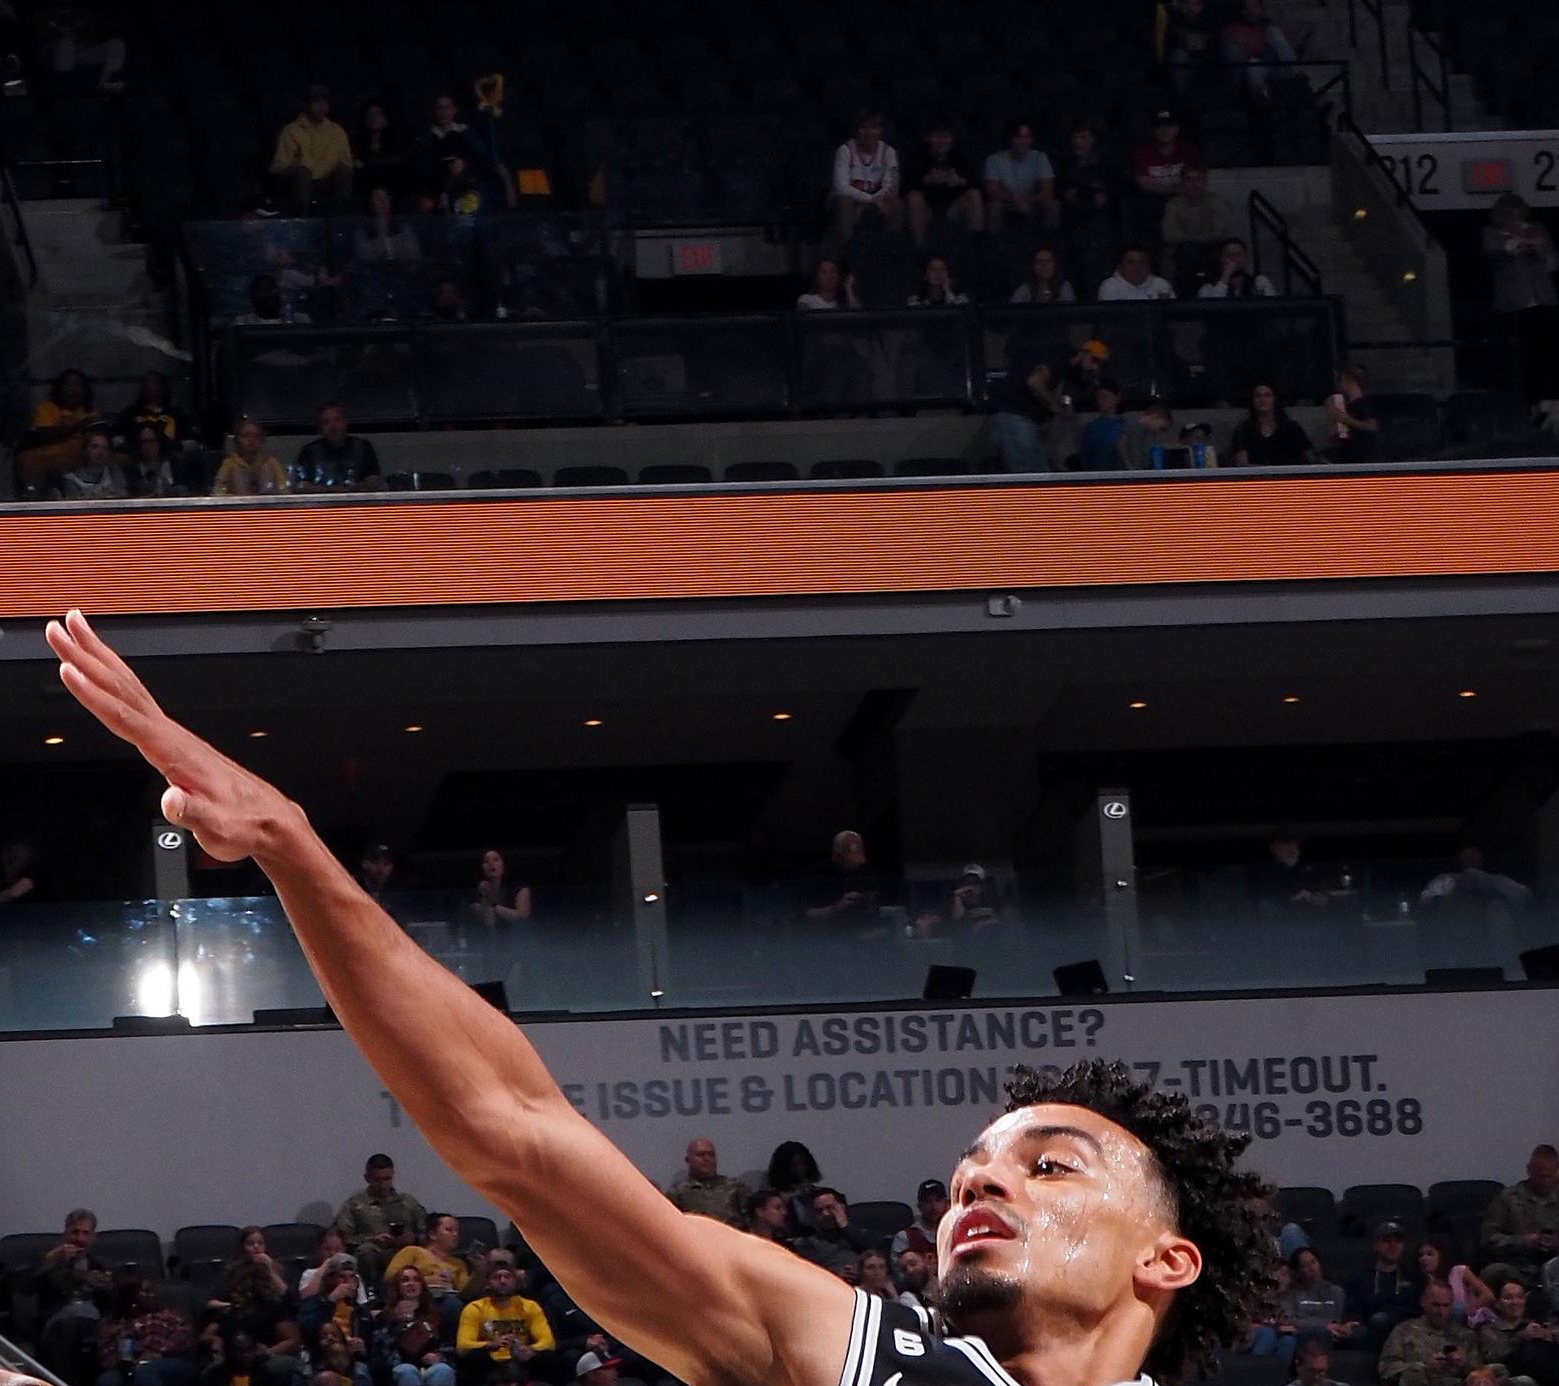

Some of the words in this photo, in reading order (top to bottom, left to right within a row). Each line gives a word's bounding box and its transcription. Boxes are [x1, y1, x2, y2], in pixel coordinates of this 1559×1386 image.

[659, 1020, 779, 1063] NEED
[793, 1008, 1105, 1057] ASSISTANCE?
[597, 1076, 731, 1120] ISSUE
[742, 1075, 774, 1113] &
[784, 1067, 998, 1112] LOCATION
[1132, 1054, 1388, 1099] 7-TIMEOUT.
[893, 1328, 925, 1357] 6
